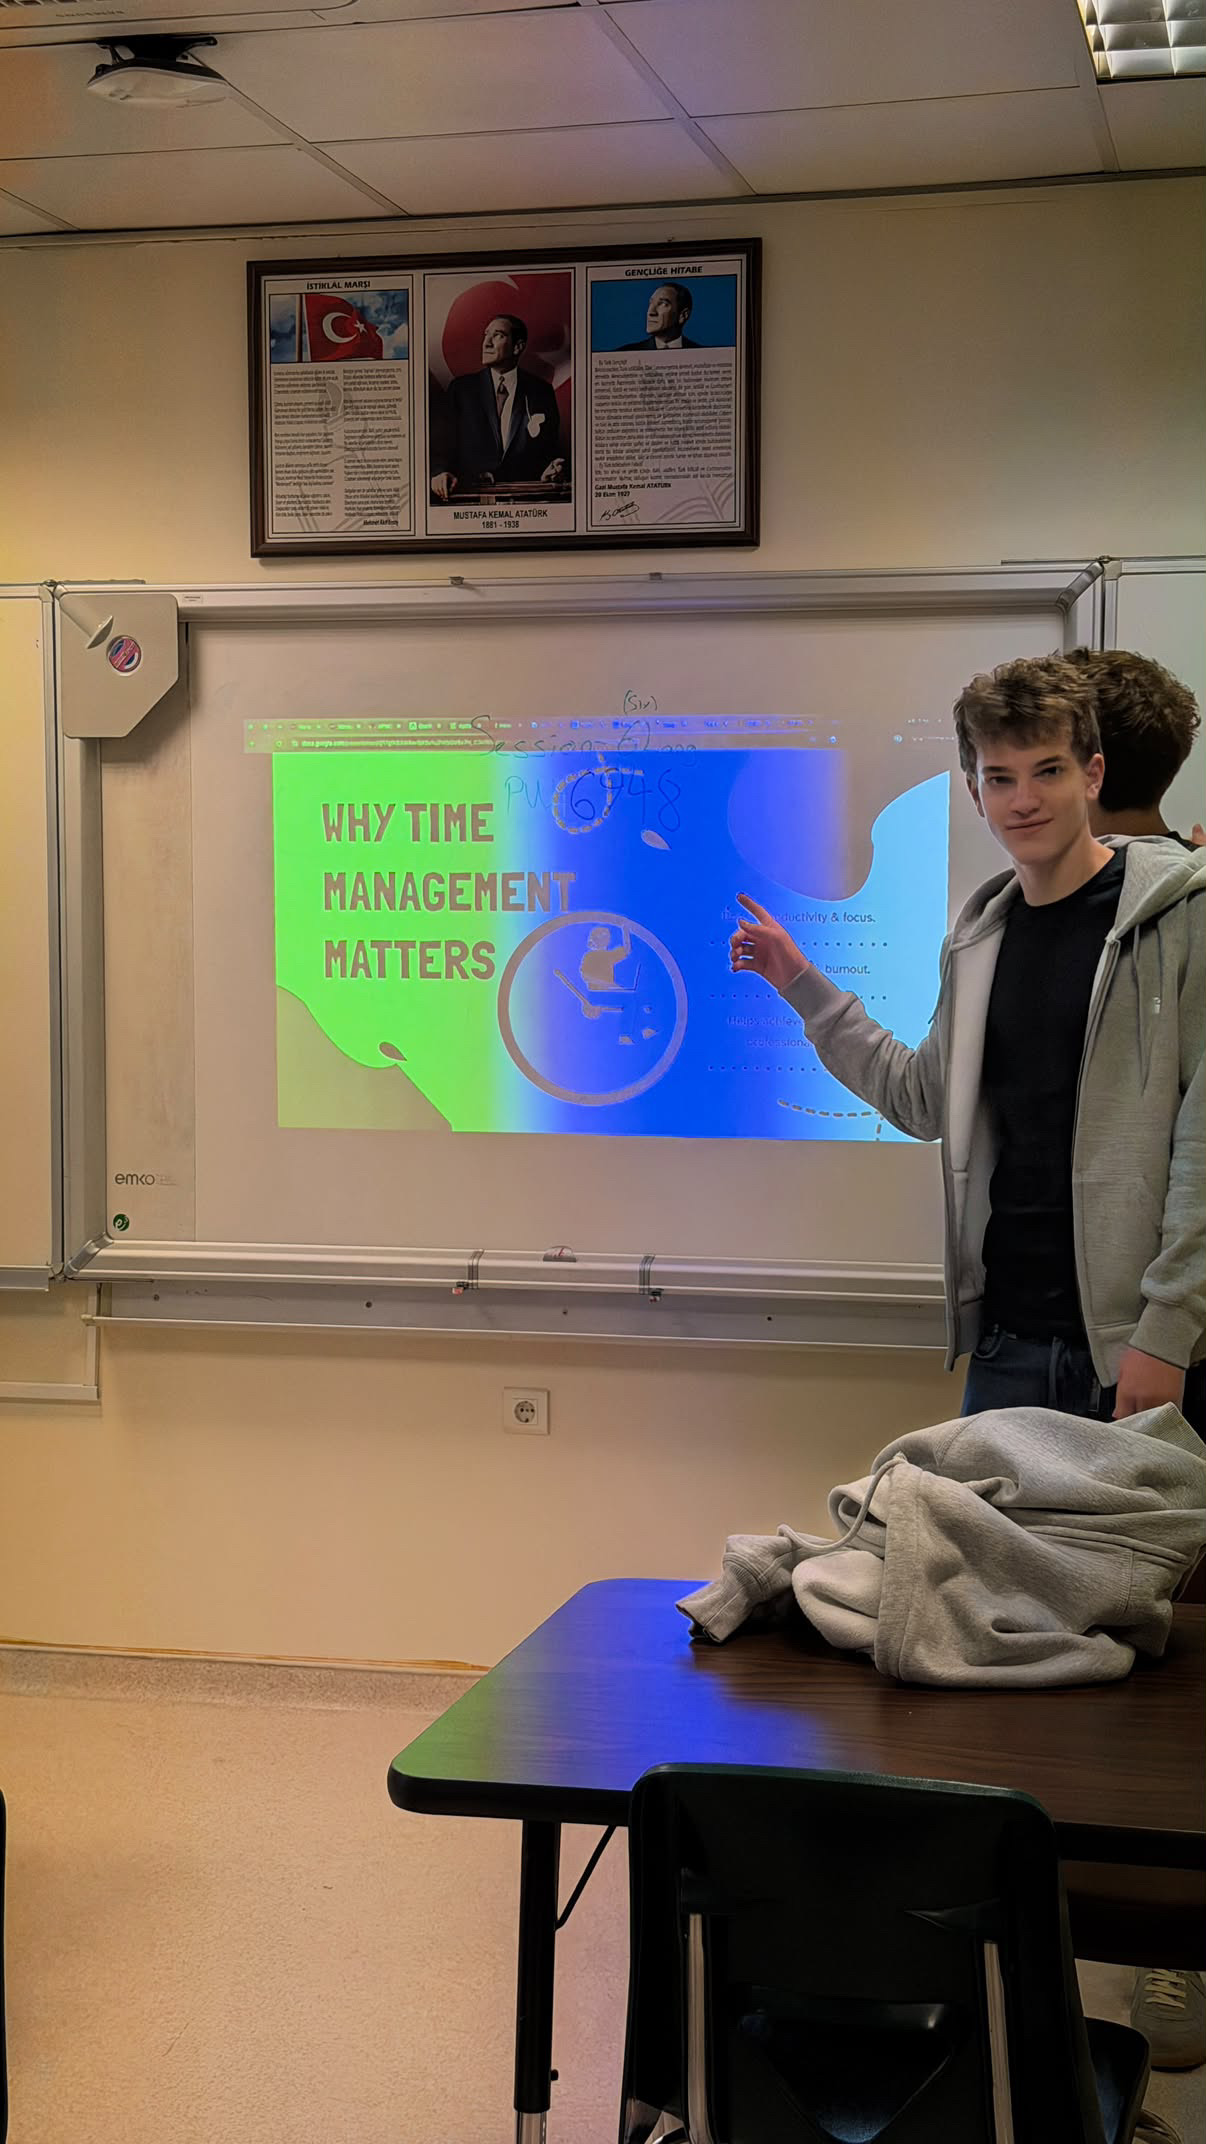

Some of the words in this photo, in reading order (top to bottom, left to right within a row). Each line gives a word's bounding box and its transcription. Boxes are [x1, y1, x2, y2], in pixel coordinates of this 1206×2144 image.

[453, 511, 487, 520] MUSTAFA
[489, 510, 514, 519] KEMAL
[515, 508, 548, 518] ATATÜRK
[482, 521, 497, 529] 1881
[571, 767, 681, 832] 6948
[322, 803, 396, 843] WHY
[405, 803, 495, 843] TIME
[324, 871, 577, 912] MANAGEMENT
[830, 912, 840, 922] &
[843, 911, 876, 923] focus.
[325, 939, 496, 980] MATTERS
[825, 965, 871, 974] burnout.
[114, 1173, 155, 1185] emko
